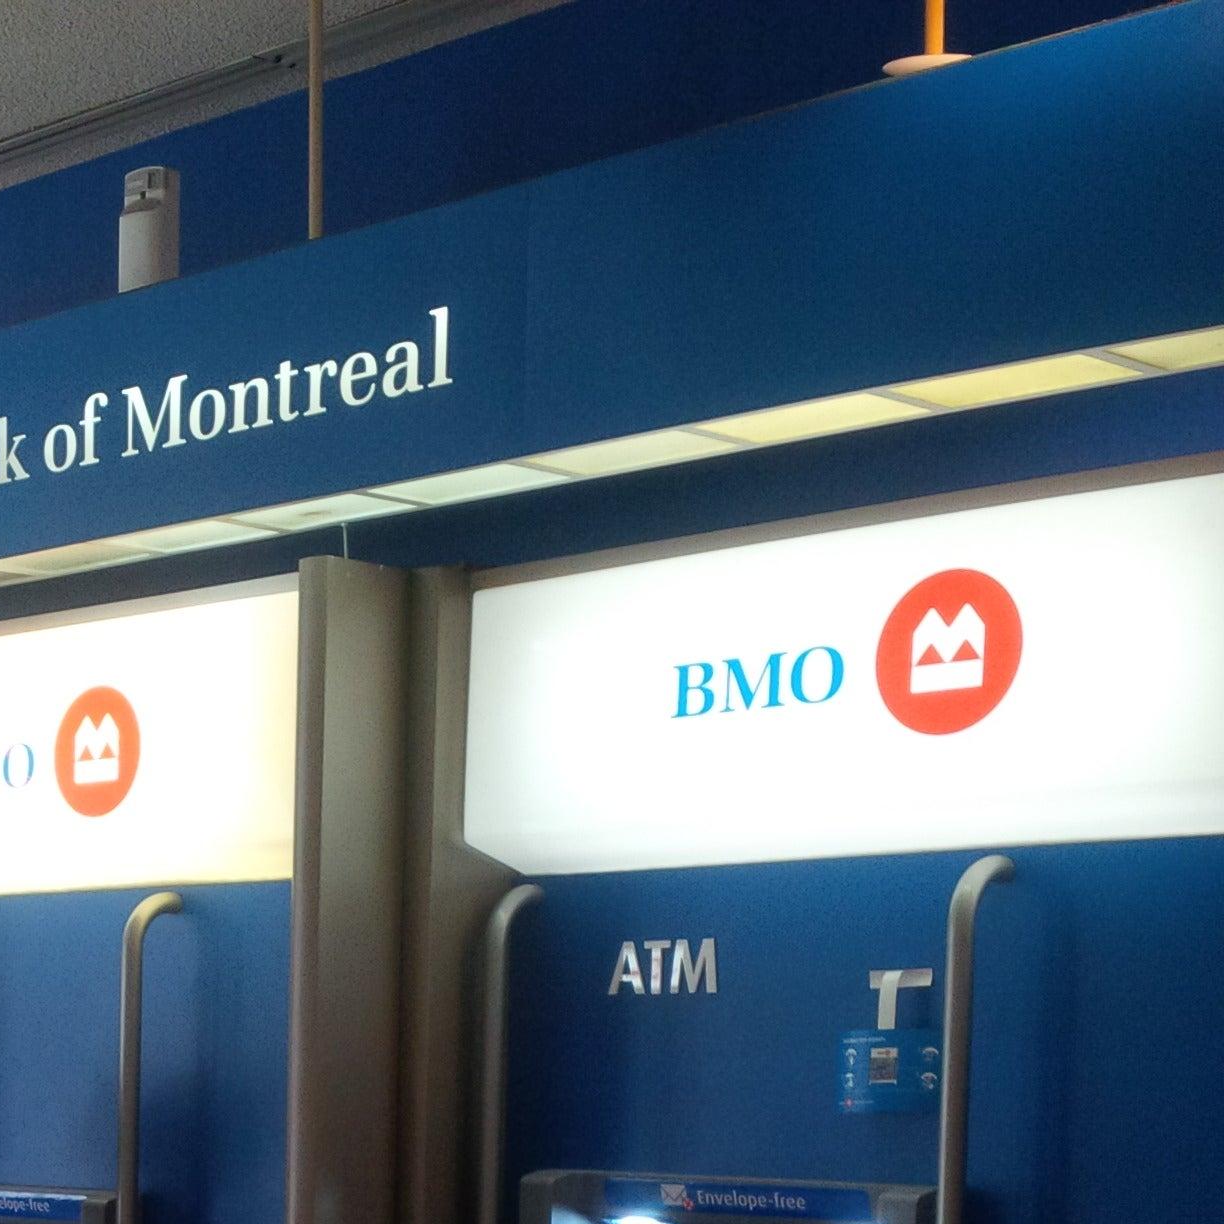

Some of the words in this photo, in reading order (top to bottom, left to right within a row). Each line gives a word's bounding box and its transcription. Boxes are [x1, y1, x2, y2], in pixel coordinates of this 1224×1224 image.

[43, 392, 108, 474] of
[121, 306, 454, 458] Montreal
[671, 646, 845, 718] BMO
[607, 937, 718, 995] ATM
[697, 1189, 806, 1211] Envelope-free
